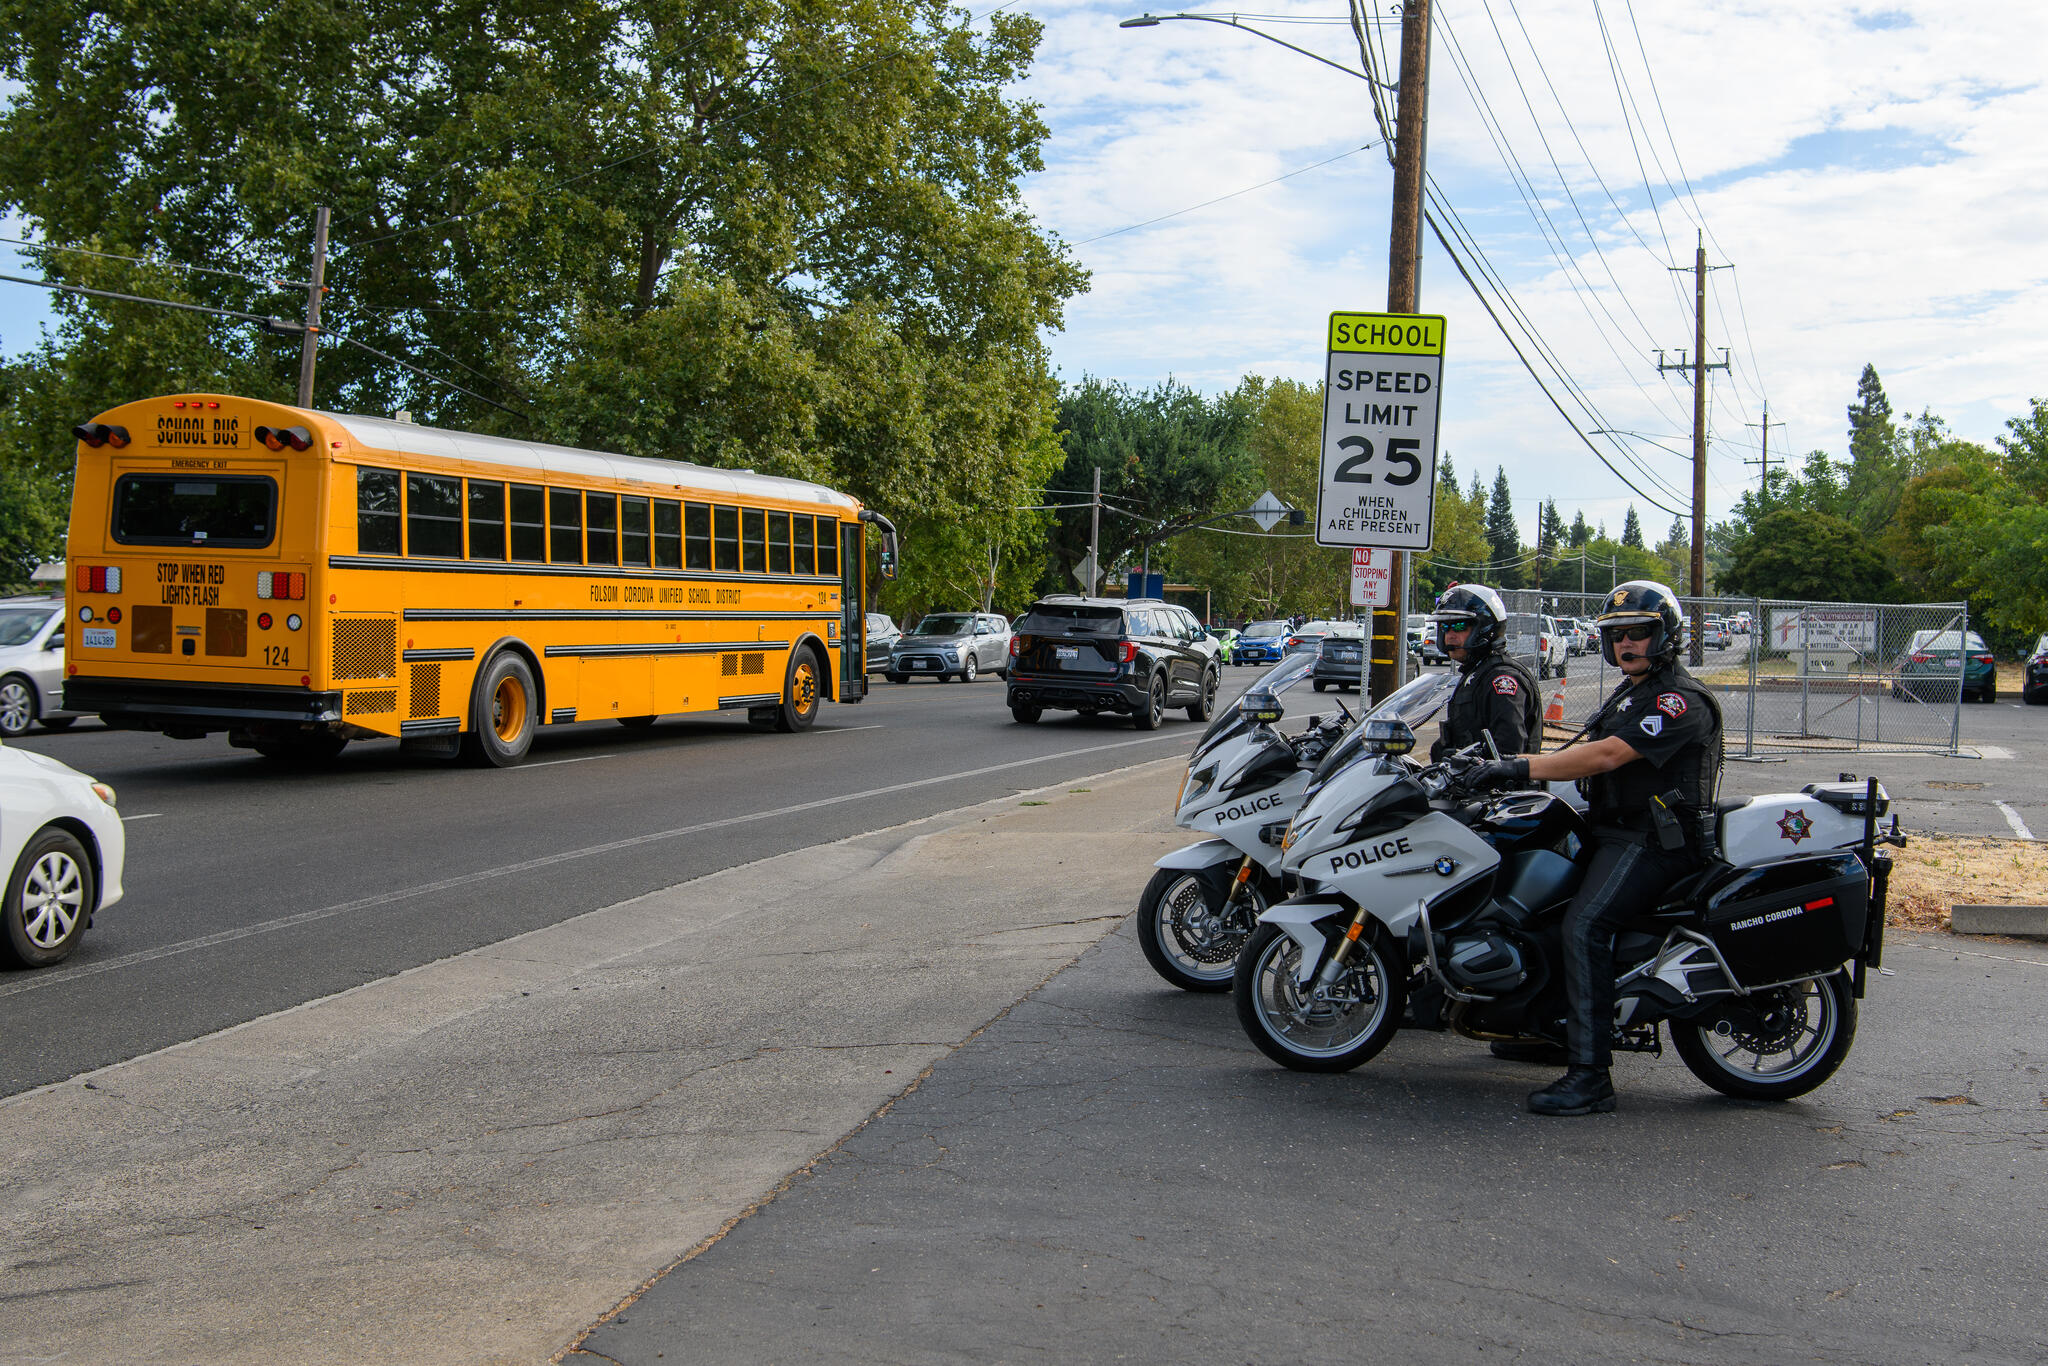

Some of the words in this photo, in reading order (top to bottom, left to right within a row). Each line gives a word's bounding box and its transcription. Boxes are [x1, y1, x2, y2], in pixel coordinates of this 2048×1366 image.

[1336, 322, 1437, 347] SCHOOL
[1336, 370, 1432, 394] SPEED
[1345, 402, 1418, 426] LIMIT
[158, 416, 207, 446] SCHOOL
[213, 416, 239, 447] BUS
[172, 460, 209, 468] EMERGENCY
[213, 460, 228, 469] EXIT
[1334, 436, 1422, 486] 25
[1358, 496, 1394, 508] WHEN
[1343, 508, 1408, 521] CHILDREN
[1328, 520, 1354, 531] ARE
[1361, 521, 1421, 534] PRESENT
[1355, 550, 1370, 564] NO
[157, 562, 178, 582] STOP
[182, 564, 206, 584] WHEN
[208, 564, 224, 584] RED
[1354, 567, 1388, 580] STOPPING
[590, 585, 618, 602] FOLSOM
[624, 586, 654, 604] CORDOVA
[659, 587, 683, 604] UNIFIED
[688, 588, 711, 604] SCHOOL
[716, 589, 742, 605] DISTRICT
[1362, 590, 1377, 600] TIME
[1364, 580, 1377, 590] ANY
[162, 586, 190, 606] LIGHTS
[192, 586, 219, 606] FLASH
[818, 591, 826, 606] 124
[264, 646, 290, 666] 124
[1214, 792, 1284, 826] POLICE
[1330, 837, 1413, 874] POLICE
[1730, 916, 1764, 931] RANCHO
[1765, 906, 1804, 923] CORDOVA
